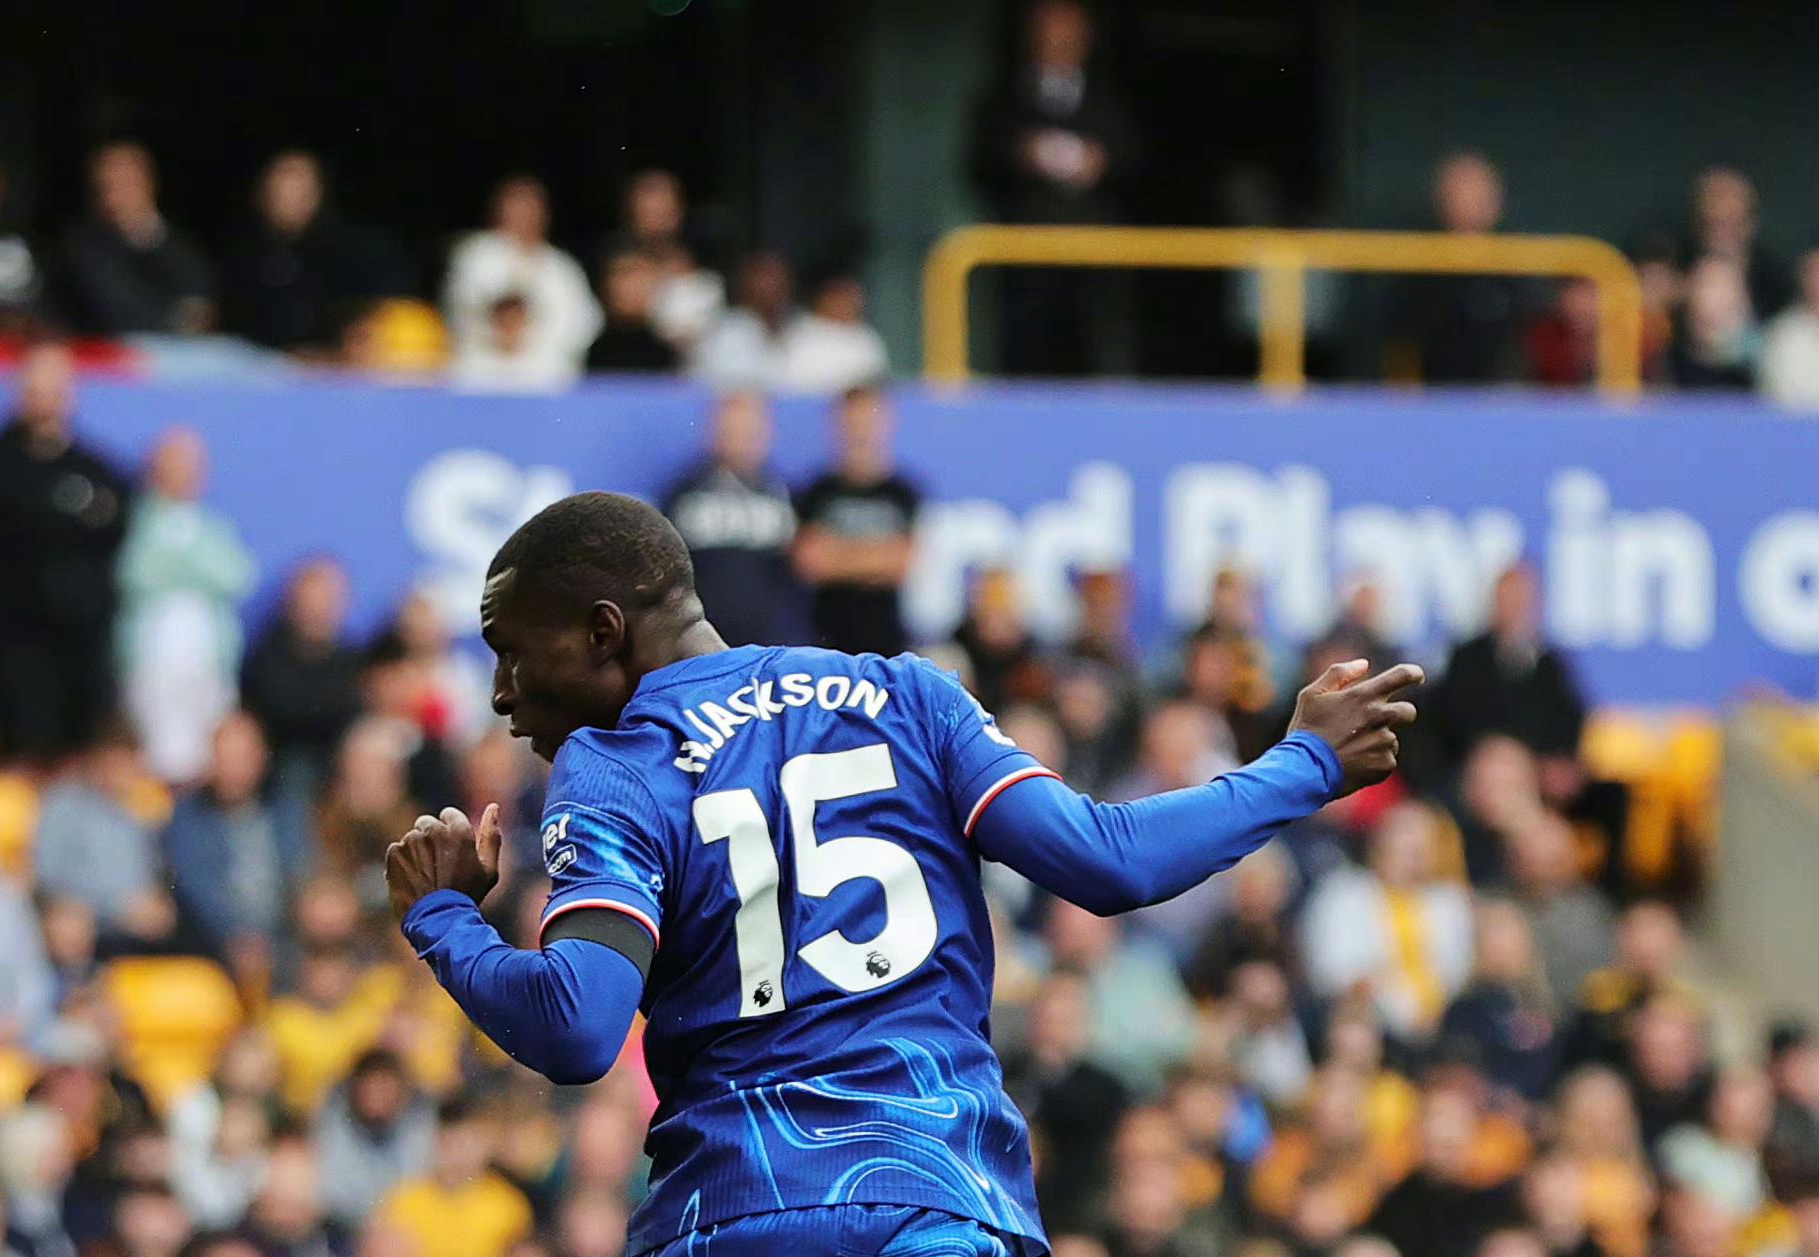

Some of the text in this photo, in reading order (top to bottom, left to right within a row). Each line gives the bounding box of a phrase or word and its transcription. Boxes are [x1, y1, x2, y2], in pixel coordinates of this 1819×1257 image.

[901, 459, 1133, 644] nd
[1548, 467, 1716, 650] in
[692, 744, 937, 1018] 15
